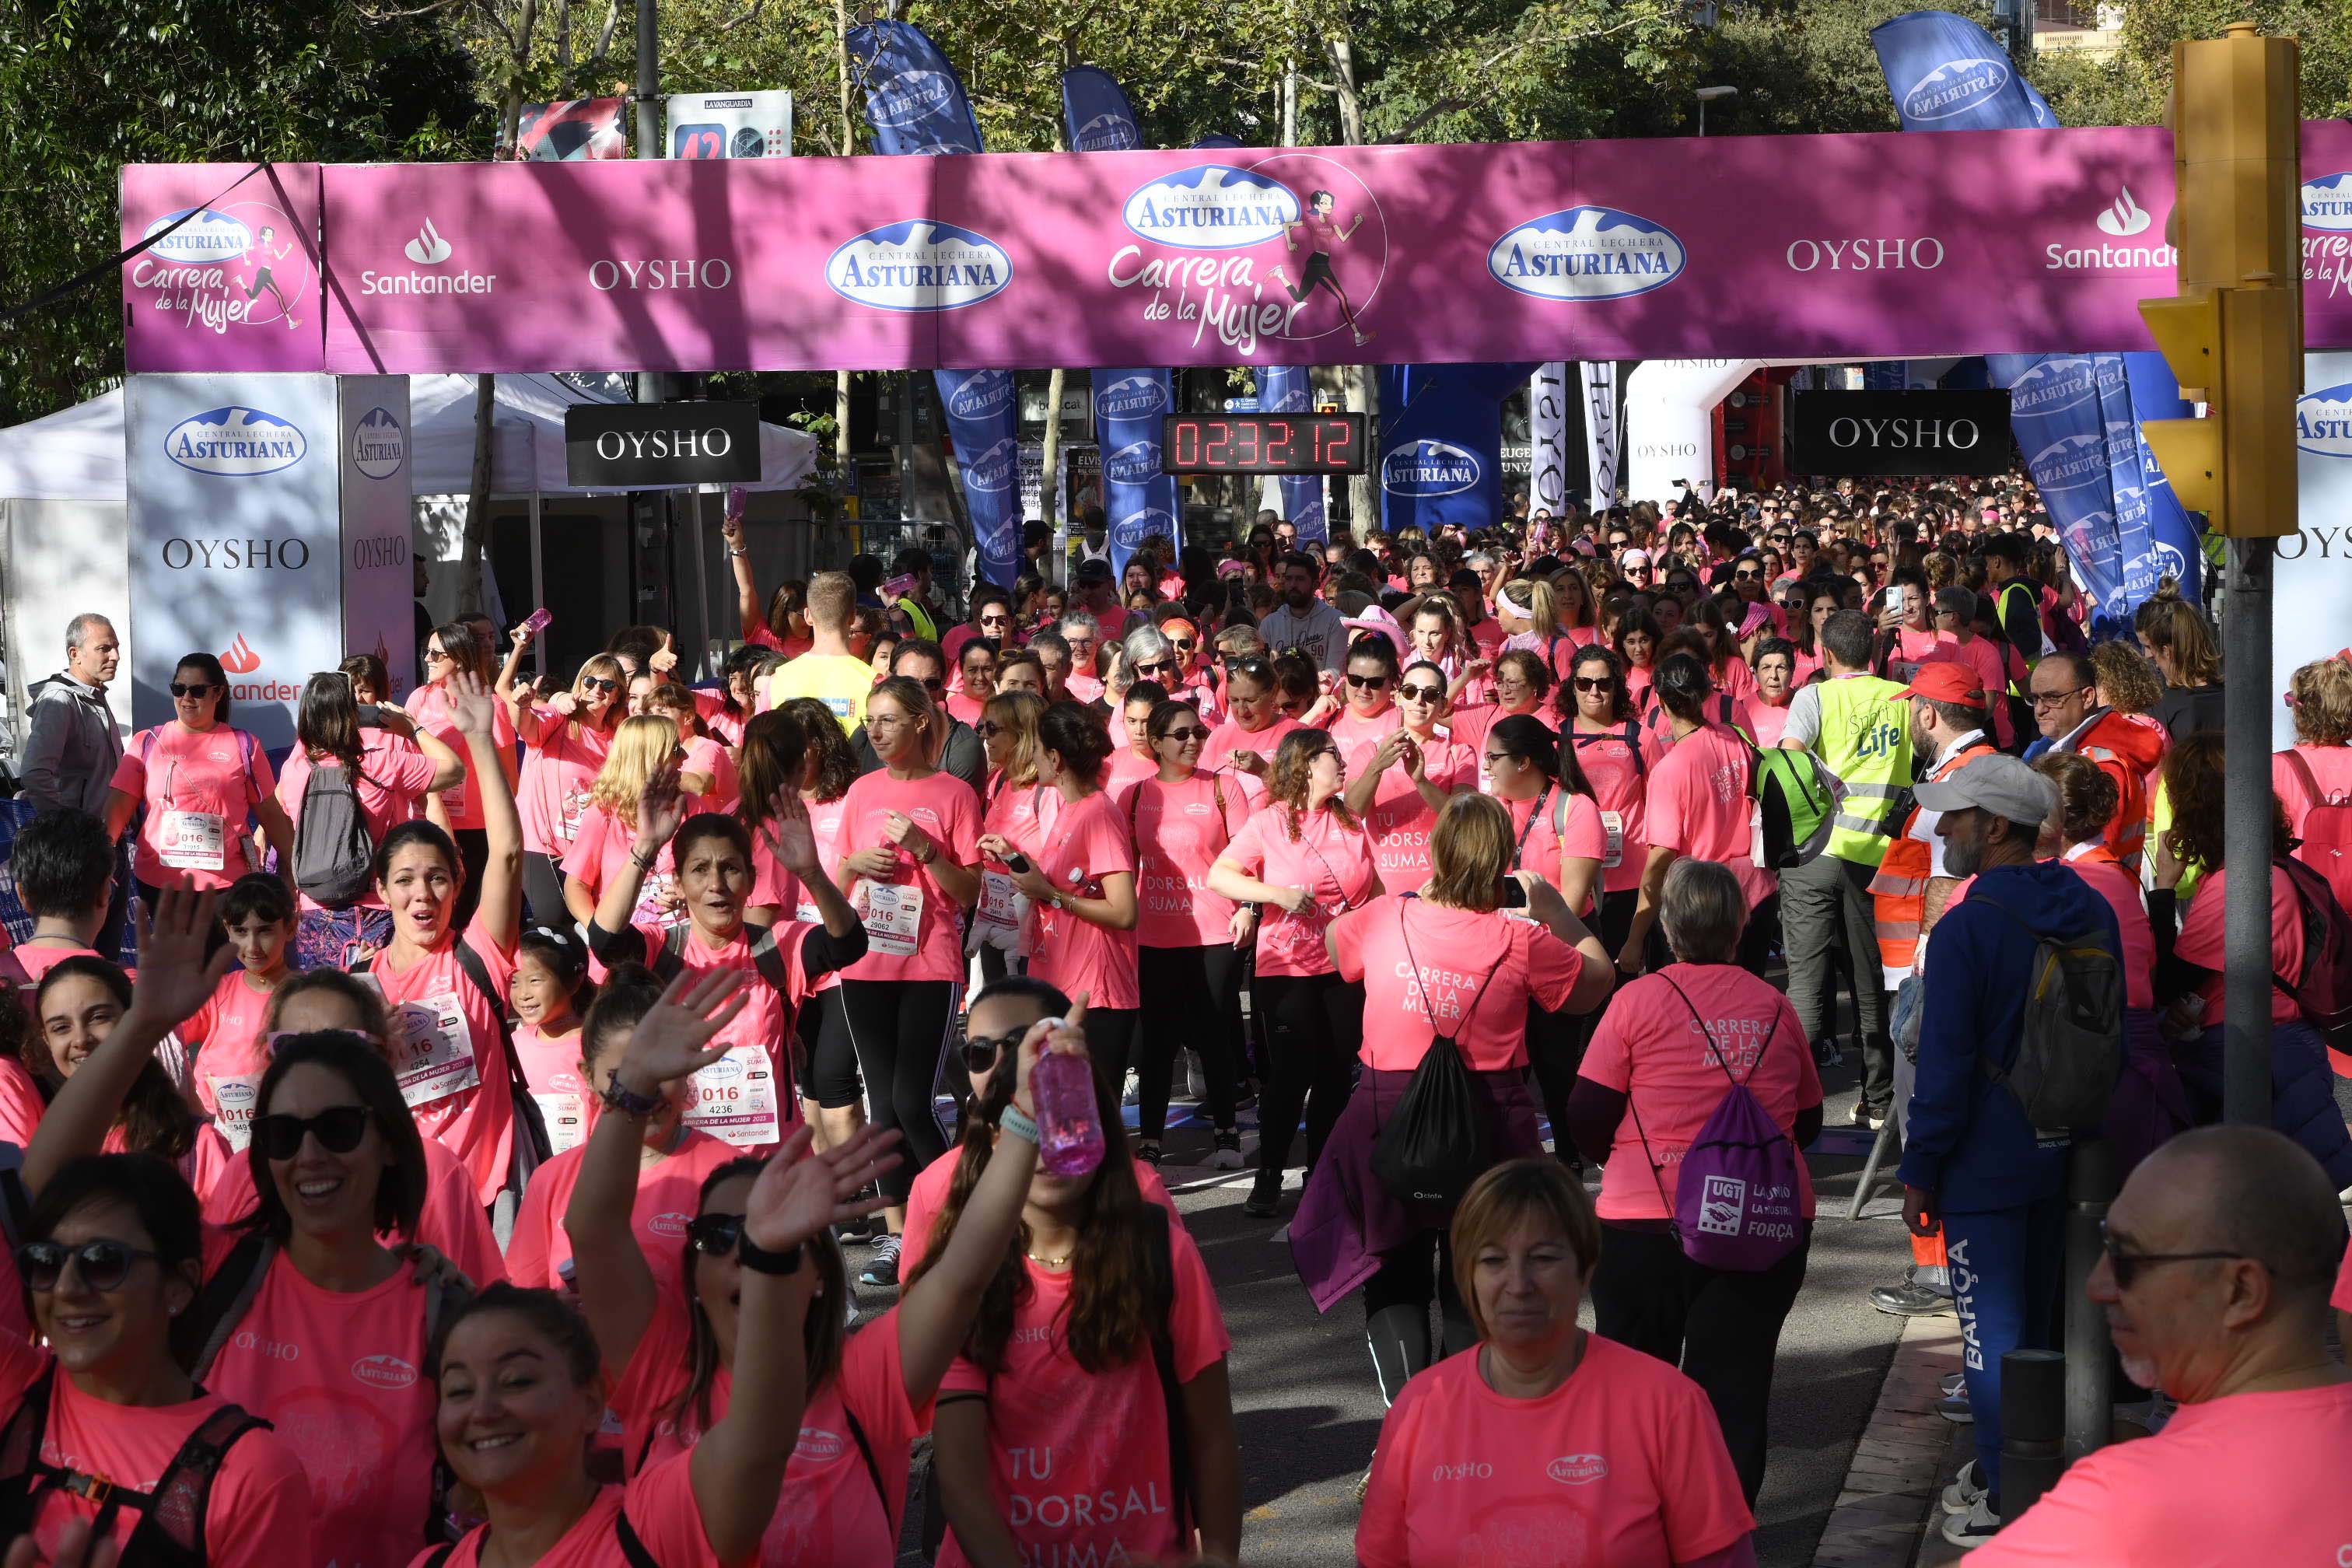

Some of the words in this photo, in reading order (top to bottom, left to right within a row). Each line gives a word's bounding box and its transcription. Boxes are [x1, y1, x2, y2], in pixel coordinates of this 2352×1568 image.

[1164, 194, 1221, 203] CENTRAL
[1223, 192, 1281, 201] LECHERA
[1137, 197, 1287, 229] ASTURIANA
[151, 227, 243, 249] ASTURIANA
[1533, 239, 1595, 249] CENTRAL
[1601, 237, 1664, 247] LECHERA
[869, 250, 929, 261] CENTRAL
[932, 250, 992, 260] LECHERA
[1503, 242, 1671, 277] ASTURIANA
[1787, 236, 1944, 271] OYSHO
[2046, 243, 2178, 269] Santande
[132, 259, 224, 289] Carrera
[589, 258, 732, 292] OYSHO
[841, 254, 999, 287] ASTURIANA
[1108, 243, 1249, 288] Carrera
[361, 269, 497, 295] Santander
[156, 291, 173, 310] de
[176, 289, 188, 310] la
[185, 286, 259, 334] Mujer
[1143, 292, 1171, 321] de
[1176, 289, 1196, 320] la
[1192, 282, 1308, 355] Mujer
[597, 427, 731, 460] OYSHO
[1176, 422, 1349, 465] 02:32:12
[1829, 417, 1979, 449] OYSHO
[175, 432, 297, 459] ASTURIANA
[355, 435, 401, 462] ASTURIANA
[1500, 447, 1531, 458] EUGE
[1637, 443, 1697, 459] OYSHO
[1384, 460, 1473, 485] ASTURIANA
[162, 537, 310, 569] OYSHO
[354, 534, 405, 570] OYSHO
[230, 679, 302, 701] ander
[1850, 705, 1892, 735] Sport
[1857, 723, 1899, 757] Life
[1377, 813, 1394, 828] TU
[181, 834, 204, 842] 016
[1380, 831, 1431, 847] DORSA
[1381, 852, 1429, 868] SUMA
[1146, 877, 1206, 891] DORSAL
[989, 896, 1005, 908] 016
[1149, 896, 1193, 911] SUMA
[870, 908, 894, 922] 016
[870, 921, 890, 931] 29062
[1395, 962, 1476, 991] CARRERA
[1408, 981, 1430, 999] DE
[1437, 986, 1458, 1003] LA
[1402, 996, 1461, 1019] MUJER
[1690, 1018, 1773, 1034] CARRERA
[410, 1038, 433, 1056] 16
[1707, 1034, 1730, 1050] DE
[1738, 1035, 1761, 1050] LA
[409, 1058, 430, 1072] 4254
[429, 1065, 451, 1076] MUJER
[1702, 1051, 1763, 1069] MUJER
[702, 1086, 739, 1101] 016
[226, 1108, 255, 1121] 016
[709, 1104, 733, 1114] 4236
[736, 1129, 770, 1138] Santander
[1712, 1181, 1741, 1199] UGT
[1753, 1183, 1766, 1196] LA
[1752, 1203, 1762, 1214] LA
[1747, 1221, 1794, 1242] FORÇA
[1947, 1238, 1984, 1371] BARÇA
[1008, 1446, 1052, 1480] TU
[1433, 1462, 1493, 1482] OYSHO
[1010, 1481, 1166, 1527] DORSAL
